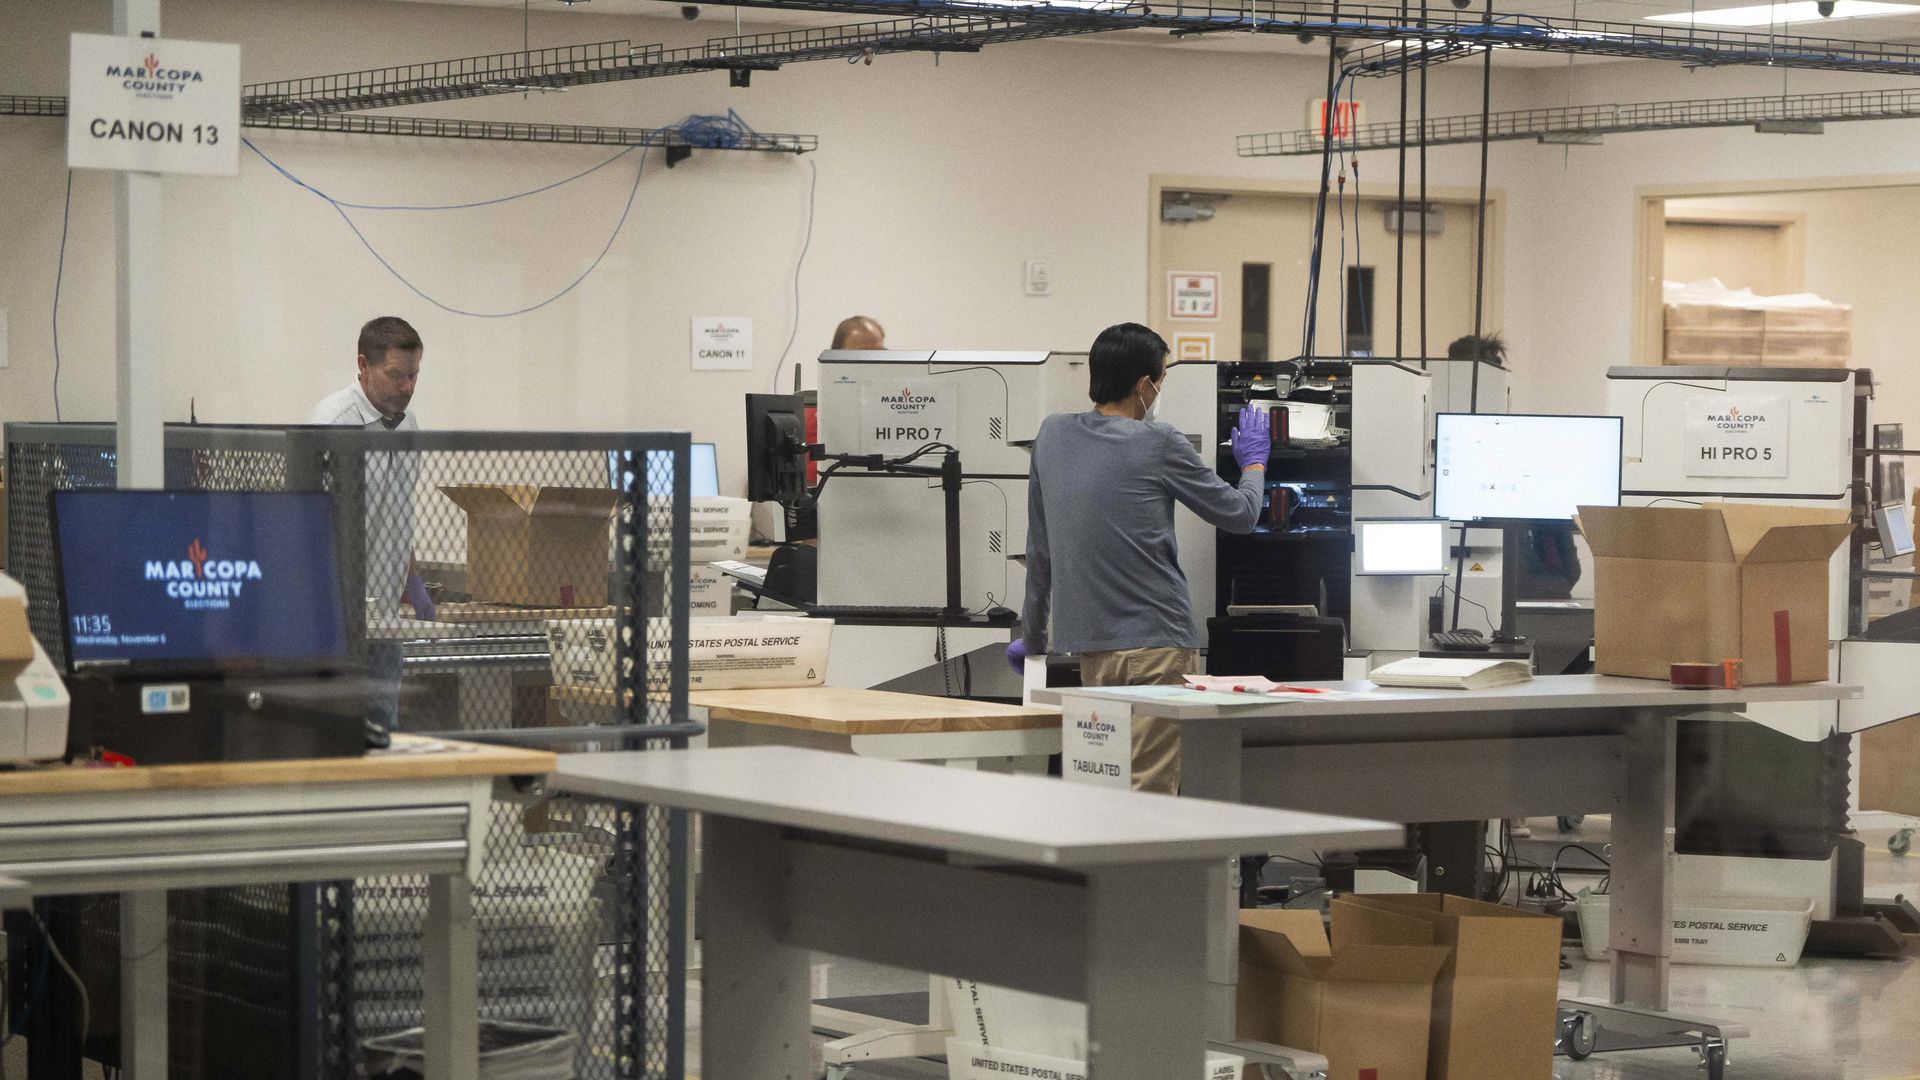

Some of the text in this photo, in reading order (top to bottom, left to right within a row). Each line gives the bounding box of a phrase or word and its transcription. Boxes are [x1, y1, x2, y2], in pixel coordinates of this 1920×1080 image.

[106, 58, 203, 82] MARICOPA
[122, 80, 186, 93] COUNTY
[90, 118, 219, 146] CANON 13
[699, 349, 745, 358] CANON 11
[881, 391, 936, 403] MARICOPA
[1707, 411, 1766, 422] MARICOPA
[876, 427, 942, 440] HI PRO 7
[1701, 447, 1772, 460] HI PRO 5
[145, 552, 262, 580] MARICOPA
[166, 581, 242, 597] COUNTY
[688, 601, 717, 609] OMING
[74, 615, 111, 633] 11:35
[650, 636, 801, 649] UNIT STATES POSTAL SERVICE
[1077, 715, 1116, 733] MARICOPA
[1083, 731, 1109, 741] COUNTY
[1073, 759, 1121, 777] TABULATED
[1688, 921, 1725, 930] POSTAL
[1727, 922, 1768, 932] SERVICE
[968, 980, 979, 1006] TAL
[971, 1057, 999, 1071] UNITED
[1000, 1062, 1030, 1077] STATES
